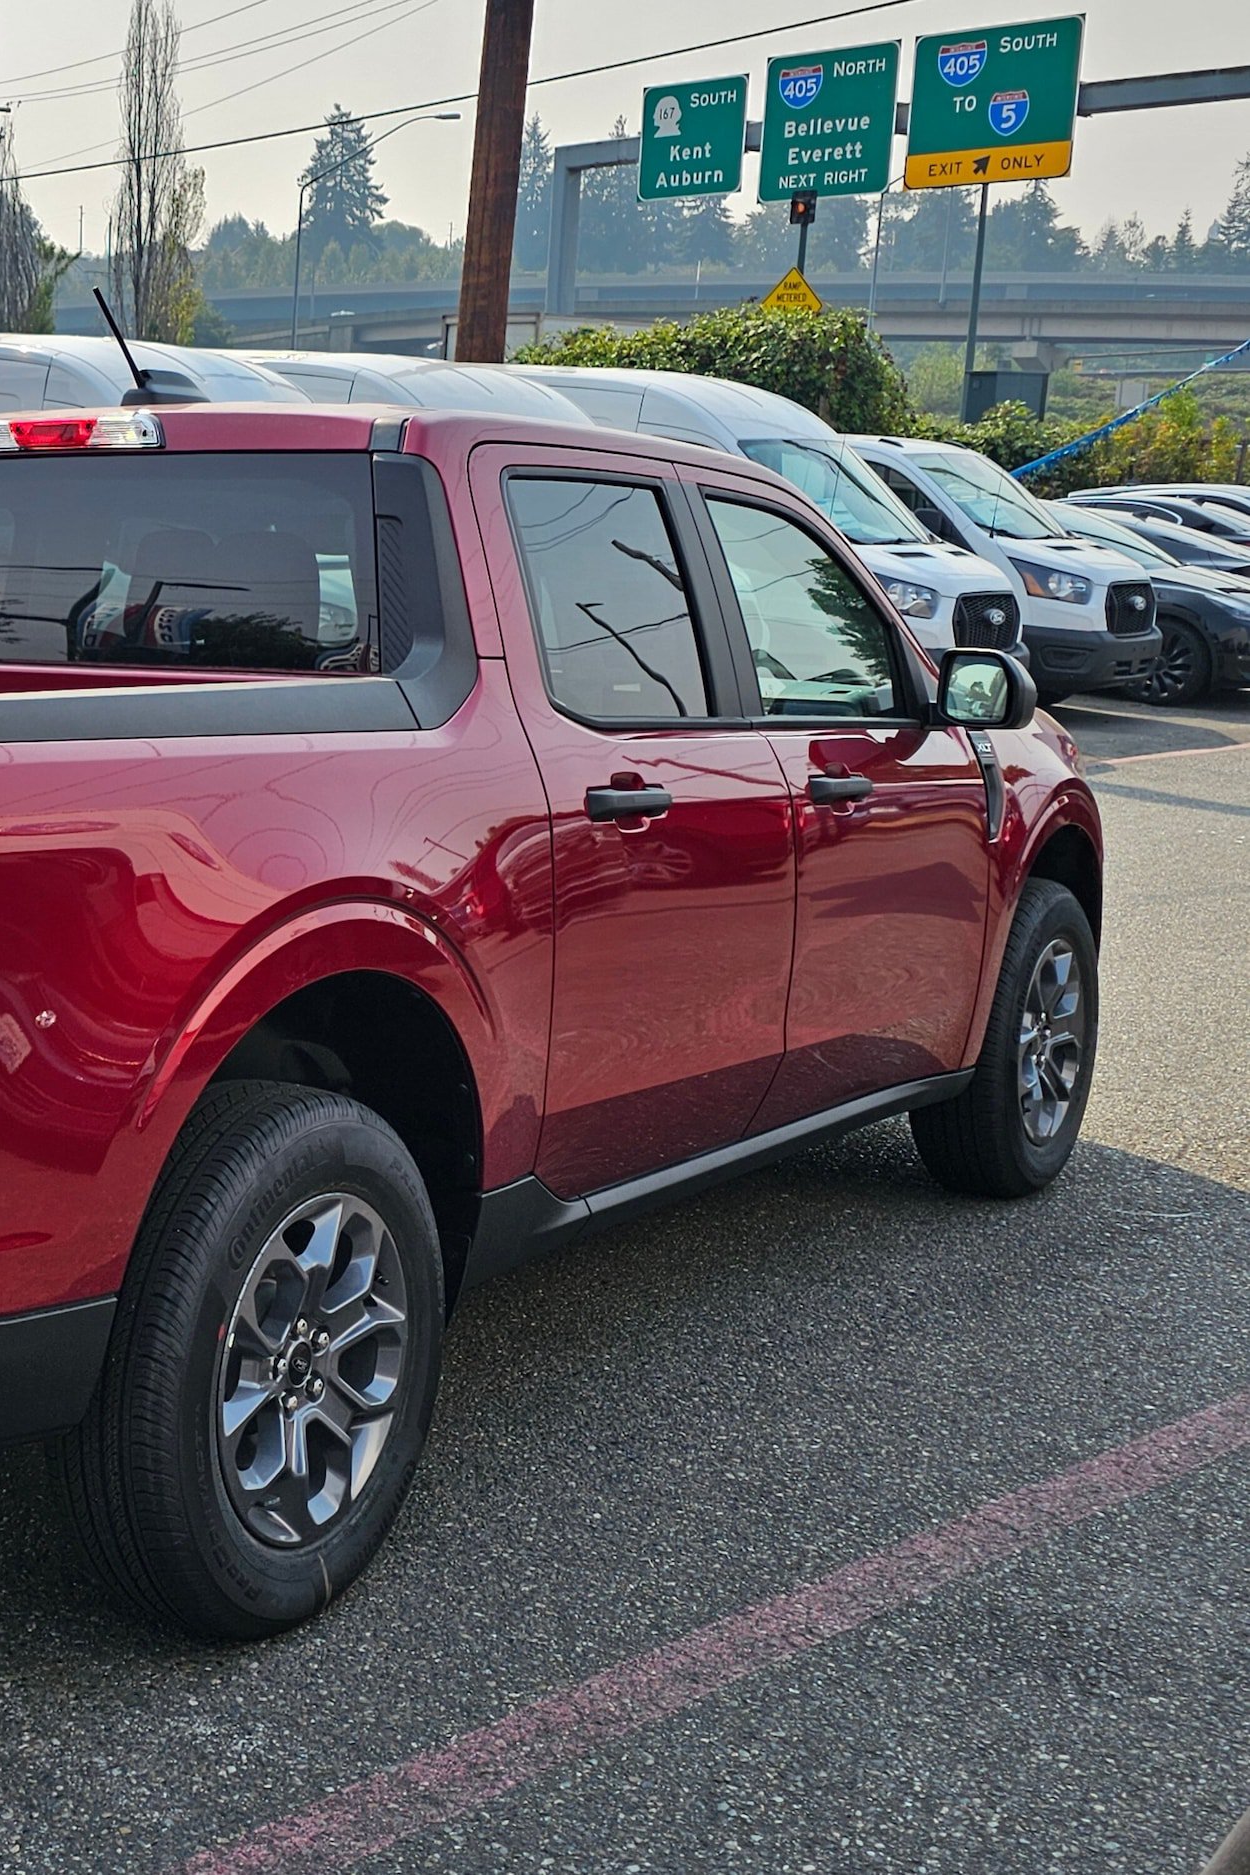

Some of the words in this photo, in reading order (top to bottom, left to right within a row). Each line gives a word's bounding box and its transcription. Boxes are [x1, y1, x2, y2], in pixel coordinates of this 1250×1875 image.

[943, 54, 980, 76] 405
[999, 32, 1057, 53] SOUTH
[783, 78, 817, 99] 405
[833, 58, 886, 77] NORTH
[659, 107, 675, 120] 167
[690, 89, 737, 108] SOUTH
[953, 95, 977, 113] TO
[1000, 104, 1016, 129] 5
[784, 116, 870, 138] Bellevue
[670, 142, 712, 161] Kent
[788, 141, 863, 165] Everett
[928, 161, 963, 177] EXIT
[1001, 154, 1044, 171] ONLY
[655, 170, 723, 189] Auburn
[779, 173, 817, 189] NEXT
[824, 168, 868, 185] RIGHT
[783, 281, 803, 290] RAMP
[776, 293, 808, 302] METERED
